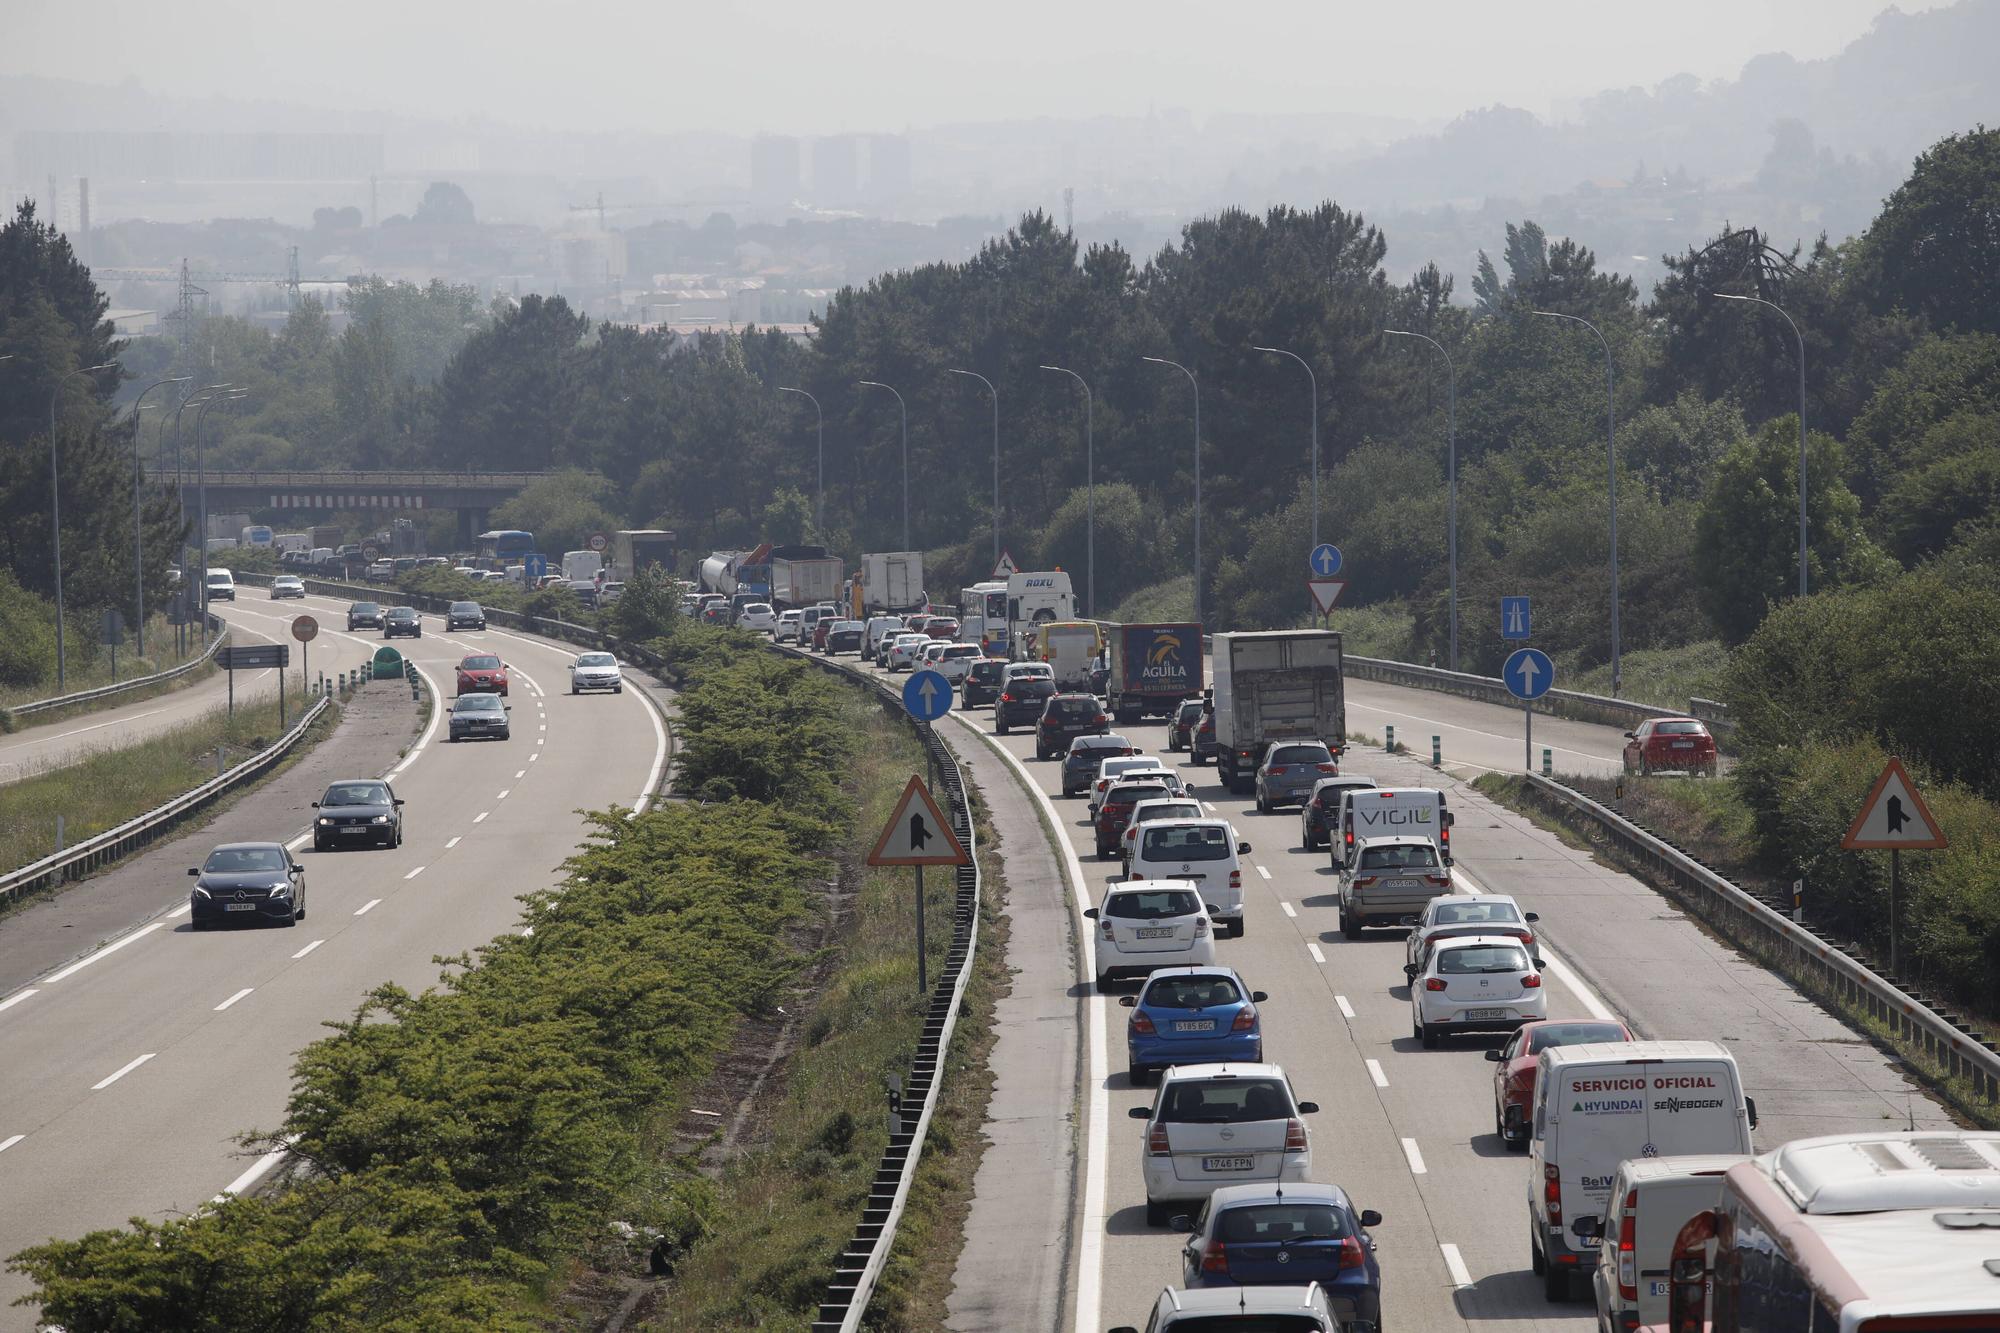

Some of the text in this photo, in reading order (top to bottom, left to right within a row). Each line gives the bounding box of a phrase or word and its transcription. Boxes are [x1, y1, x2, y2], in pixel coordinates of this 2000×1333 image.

[1026, 579, 1054, 587] ROXU
[1360, 810, 1432, 825] VIGIL
[1572, 1077, 1716, 1092] SERVICIO OFICIAL
[1584, 1100, 1642, 1111] HYUNDAI
[1210, 1158, 1252, 1168] 1746 FPN
[1581, 1176, 1614, 1186] BelV
